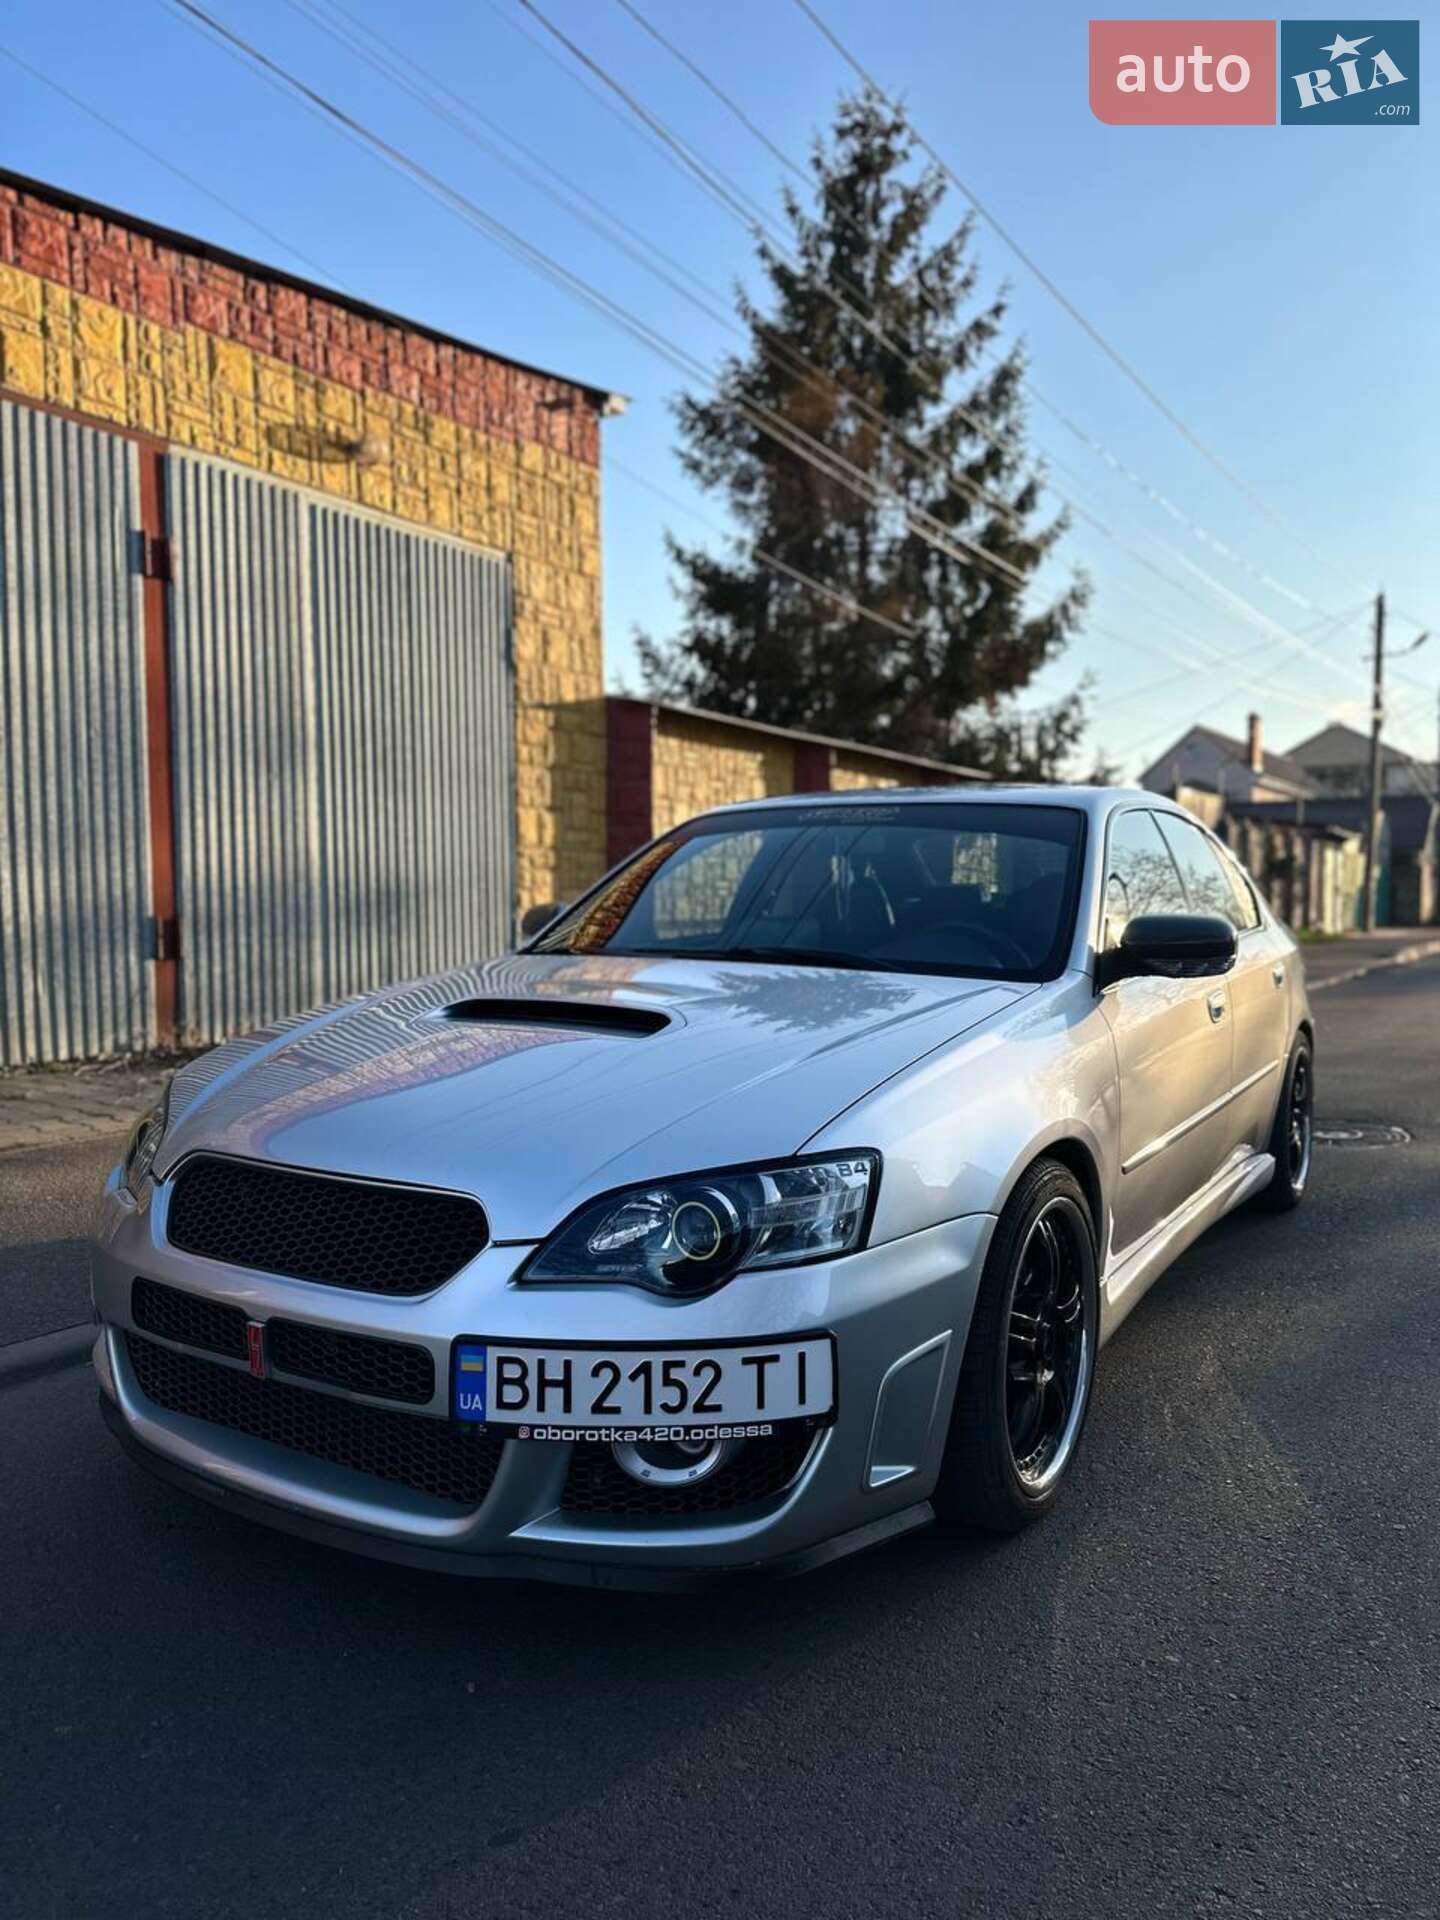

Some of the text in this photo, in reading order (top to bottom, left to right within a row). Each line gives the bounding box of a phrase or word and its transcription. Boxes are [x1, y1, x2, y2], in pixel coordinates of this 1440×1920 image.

[459, 1392, 482, 1411] UA
[496, 1356, 573, 1414] BH
[590, 1358, 723, 1415] 2152
